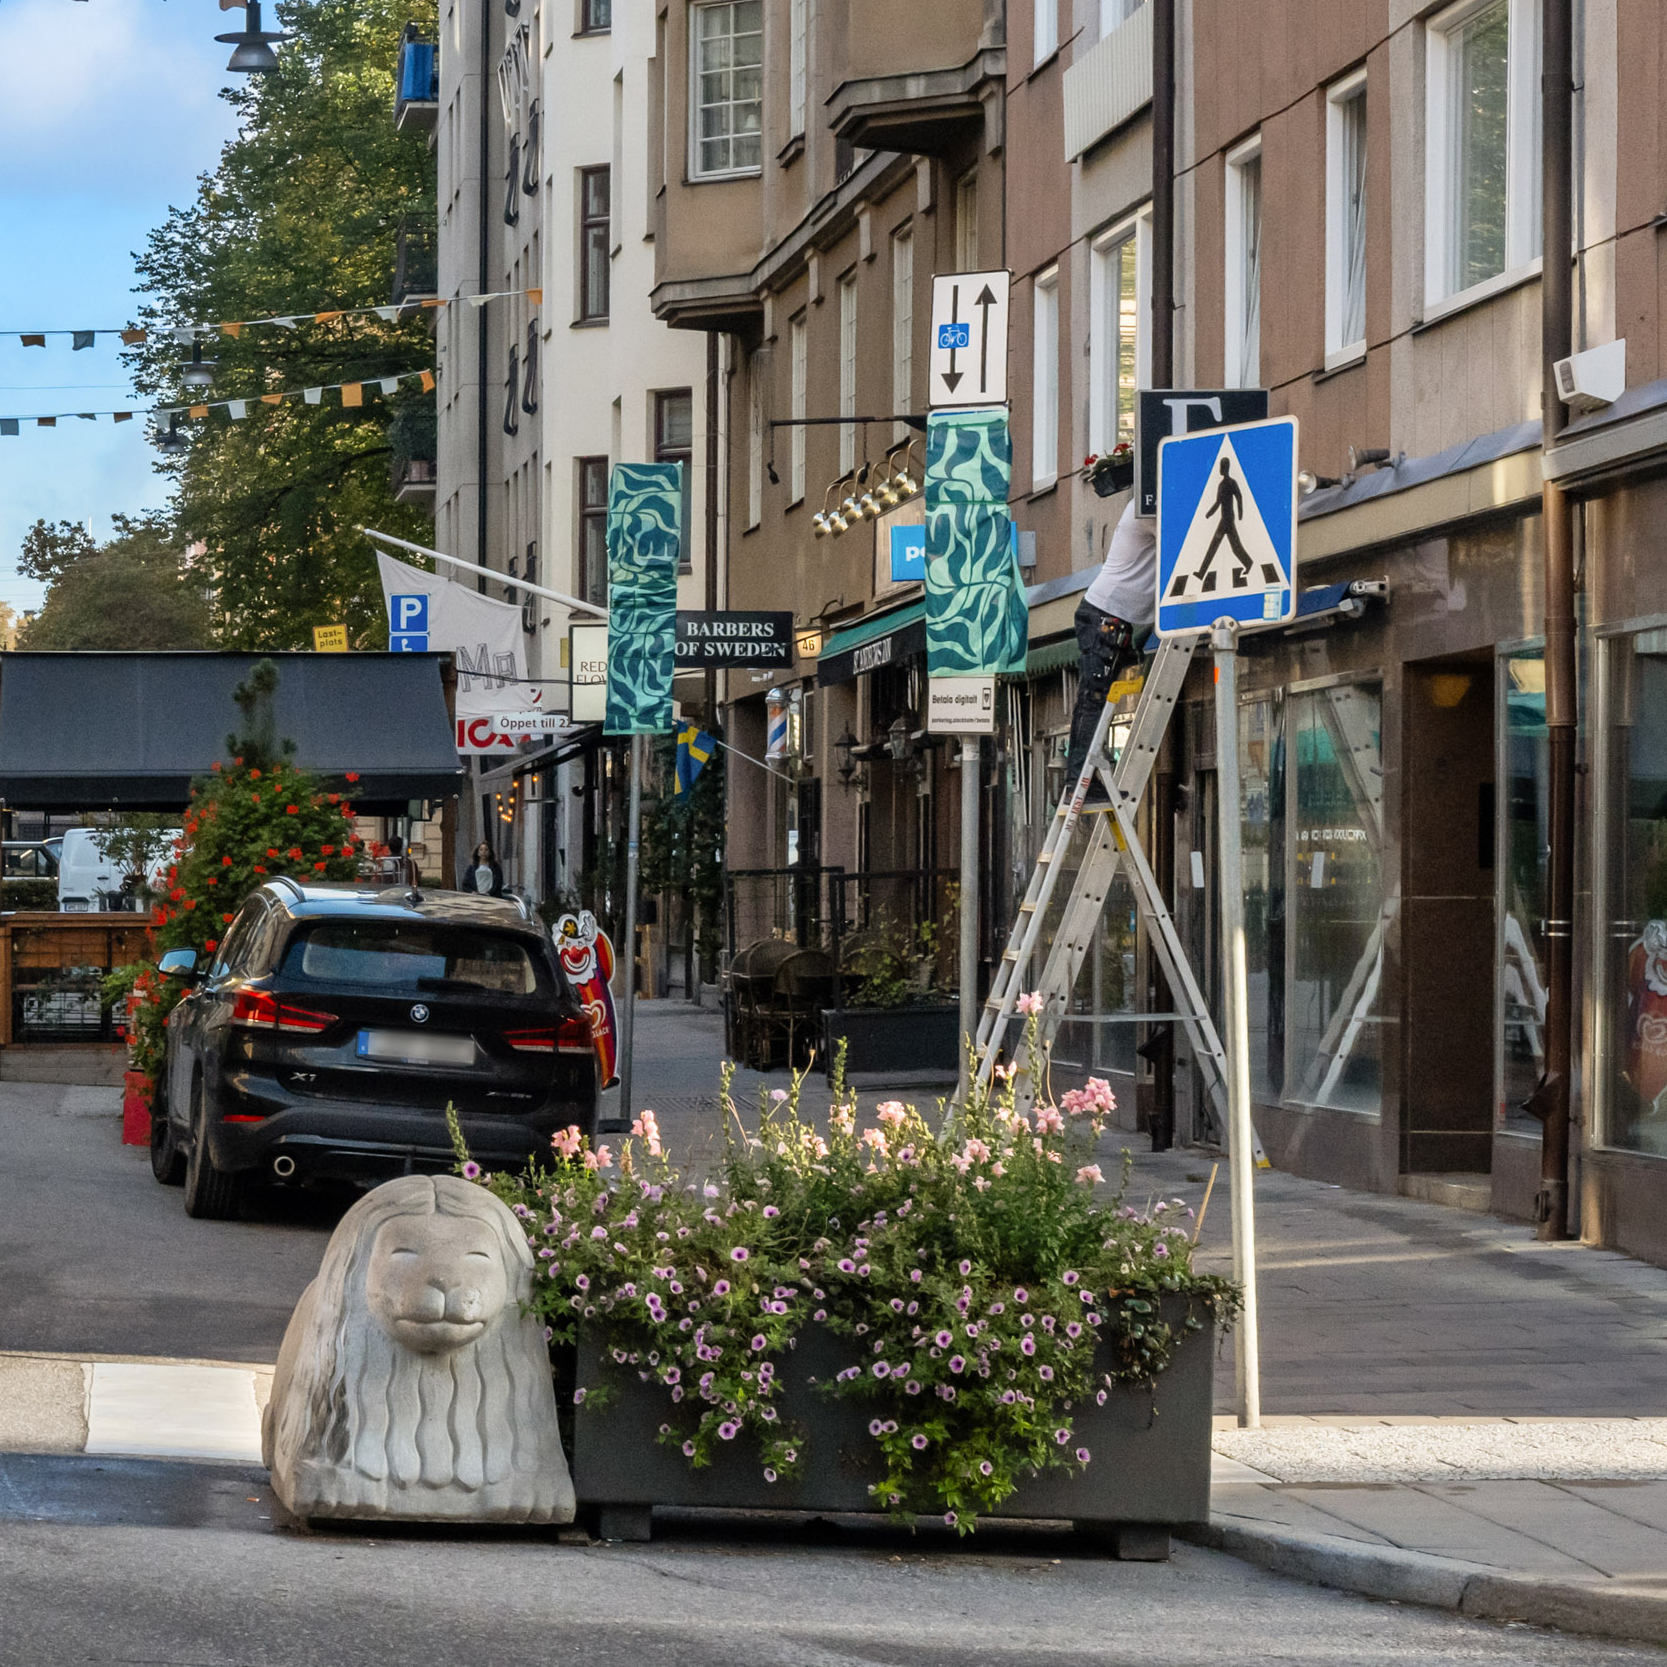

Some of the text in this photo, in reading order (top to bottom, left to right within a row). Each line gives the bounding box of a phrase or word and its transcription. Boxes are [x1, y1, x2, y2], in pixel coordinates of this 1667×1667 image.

[400, 598, 422, 629] P
[687, 622, 774, 637] BARBERS
[320, 639, 343, 649] plats
[675, 641, 786, 657] OF SWEDEN
[802, 639, 815, 651] 46
[932, 695, 978, 706] Betala digitalt
[500, 716, 537, 730] Öppet
[541, 717, 555, 728] till
